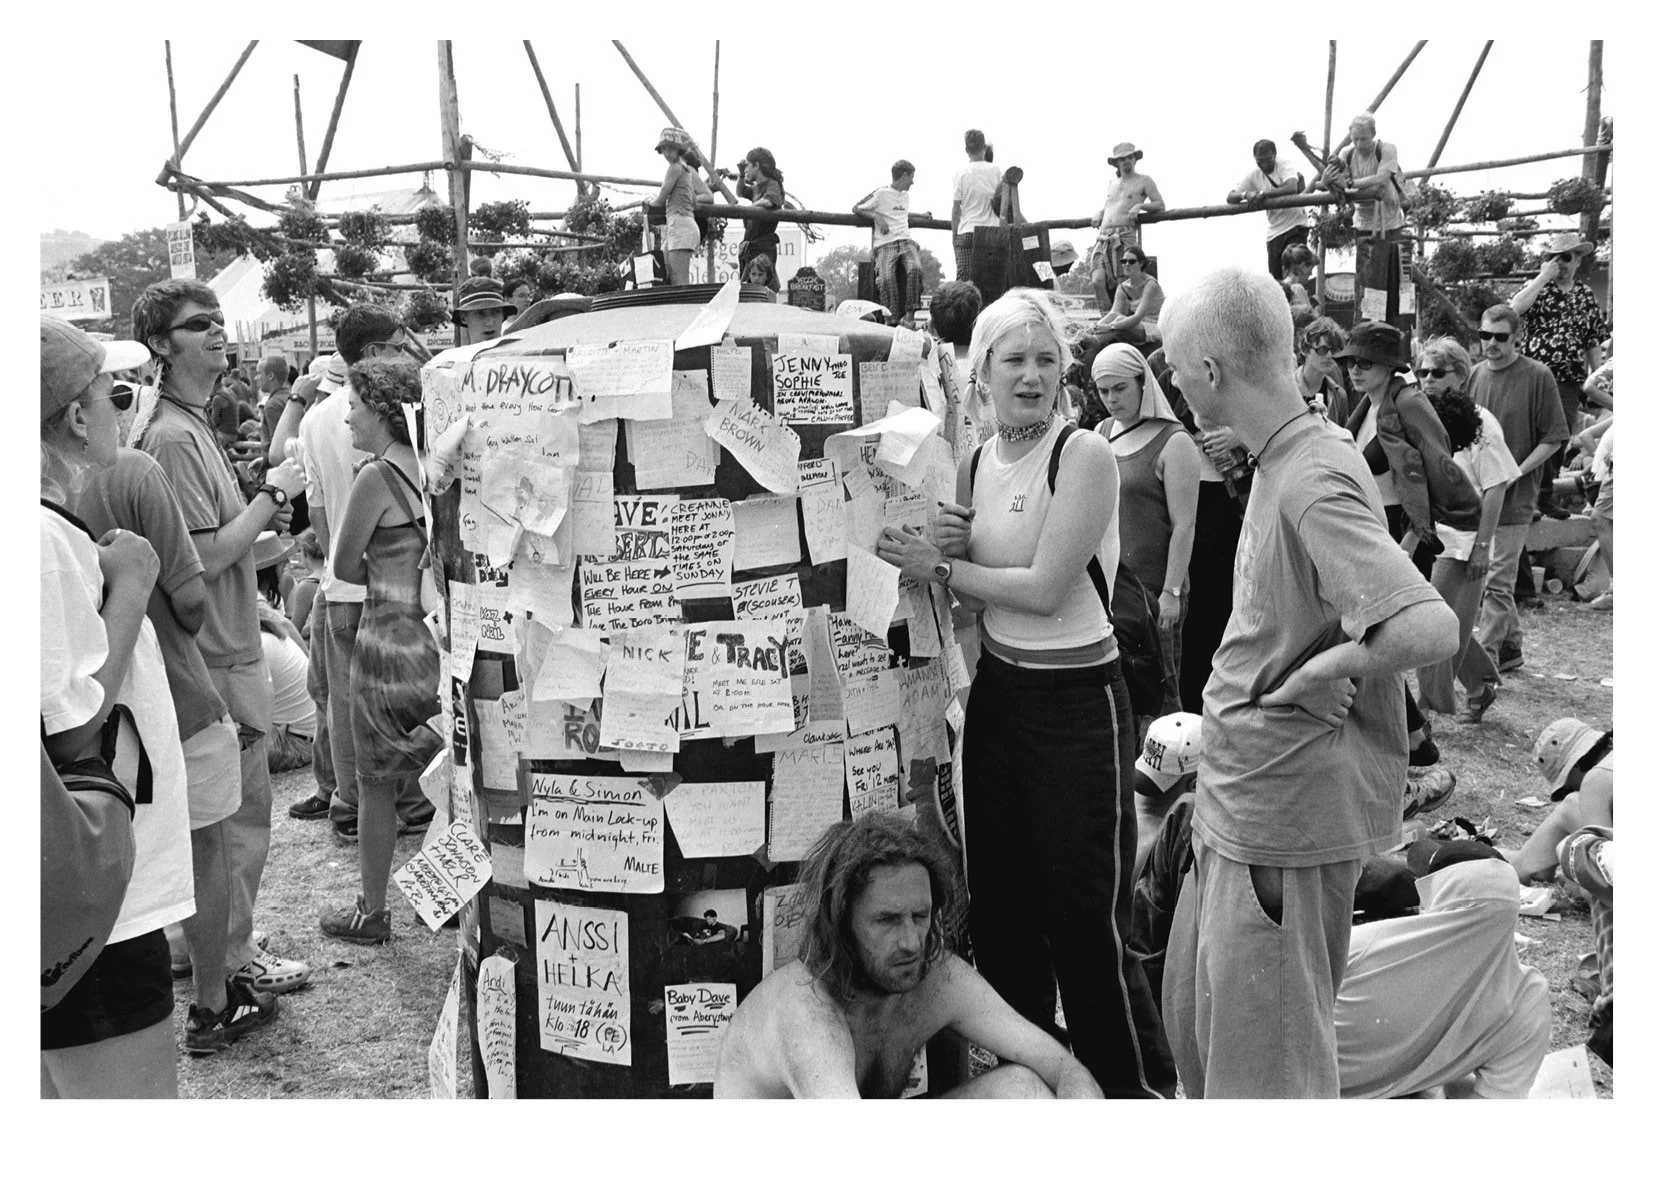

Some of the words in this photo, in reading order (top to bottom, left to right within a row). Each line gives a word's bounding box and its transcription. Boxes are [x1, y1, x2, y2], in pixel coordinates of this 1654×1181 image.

[774, 355, 831, 373] JENNY
[775, 374, 822, 389] SOPHIE
[720, 417, 765, 452] BROWN
[701, 510, 731, 521] JONNY
[672, 525, 696, 535] HERE
[699, 523, 710, 531] AT
[672, 562, 702, 572] TIMES
[707, 558, 721, 566] ON
[606, 568, 621, 581] BE
[676, 569, 724, 580] SUNDAY
[786, 577, 798, 589] T
[652, 583, 673, 592] ON
[622, 646, 672, 662] NICK
[716, 633, 789, 679] TRACY
[532, 777, 563, 796] Nyla
[586, 780, 642, 801] Simon
[555, 810, 568, 819] on
[573, 806, 604, 823] Main
[531, 824, 560, 840] from
[450, 823, 486, 863] CLARE
[438, 834, 481, 884] JOHNSON
[624, 856, 659, 874] MALTE
[541, 913, 618, 954] ANSSI
[544, 959, 623, 996] HELKA
[667, 990, 696, 1005] Baby
[697, 988, 730, 1003] Dave
[574, 1019, 590, 1039] 18
